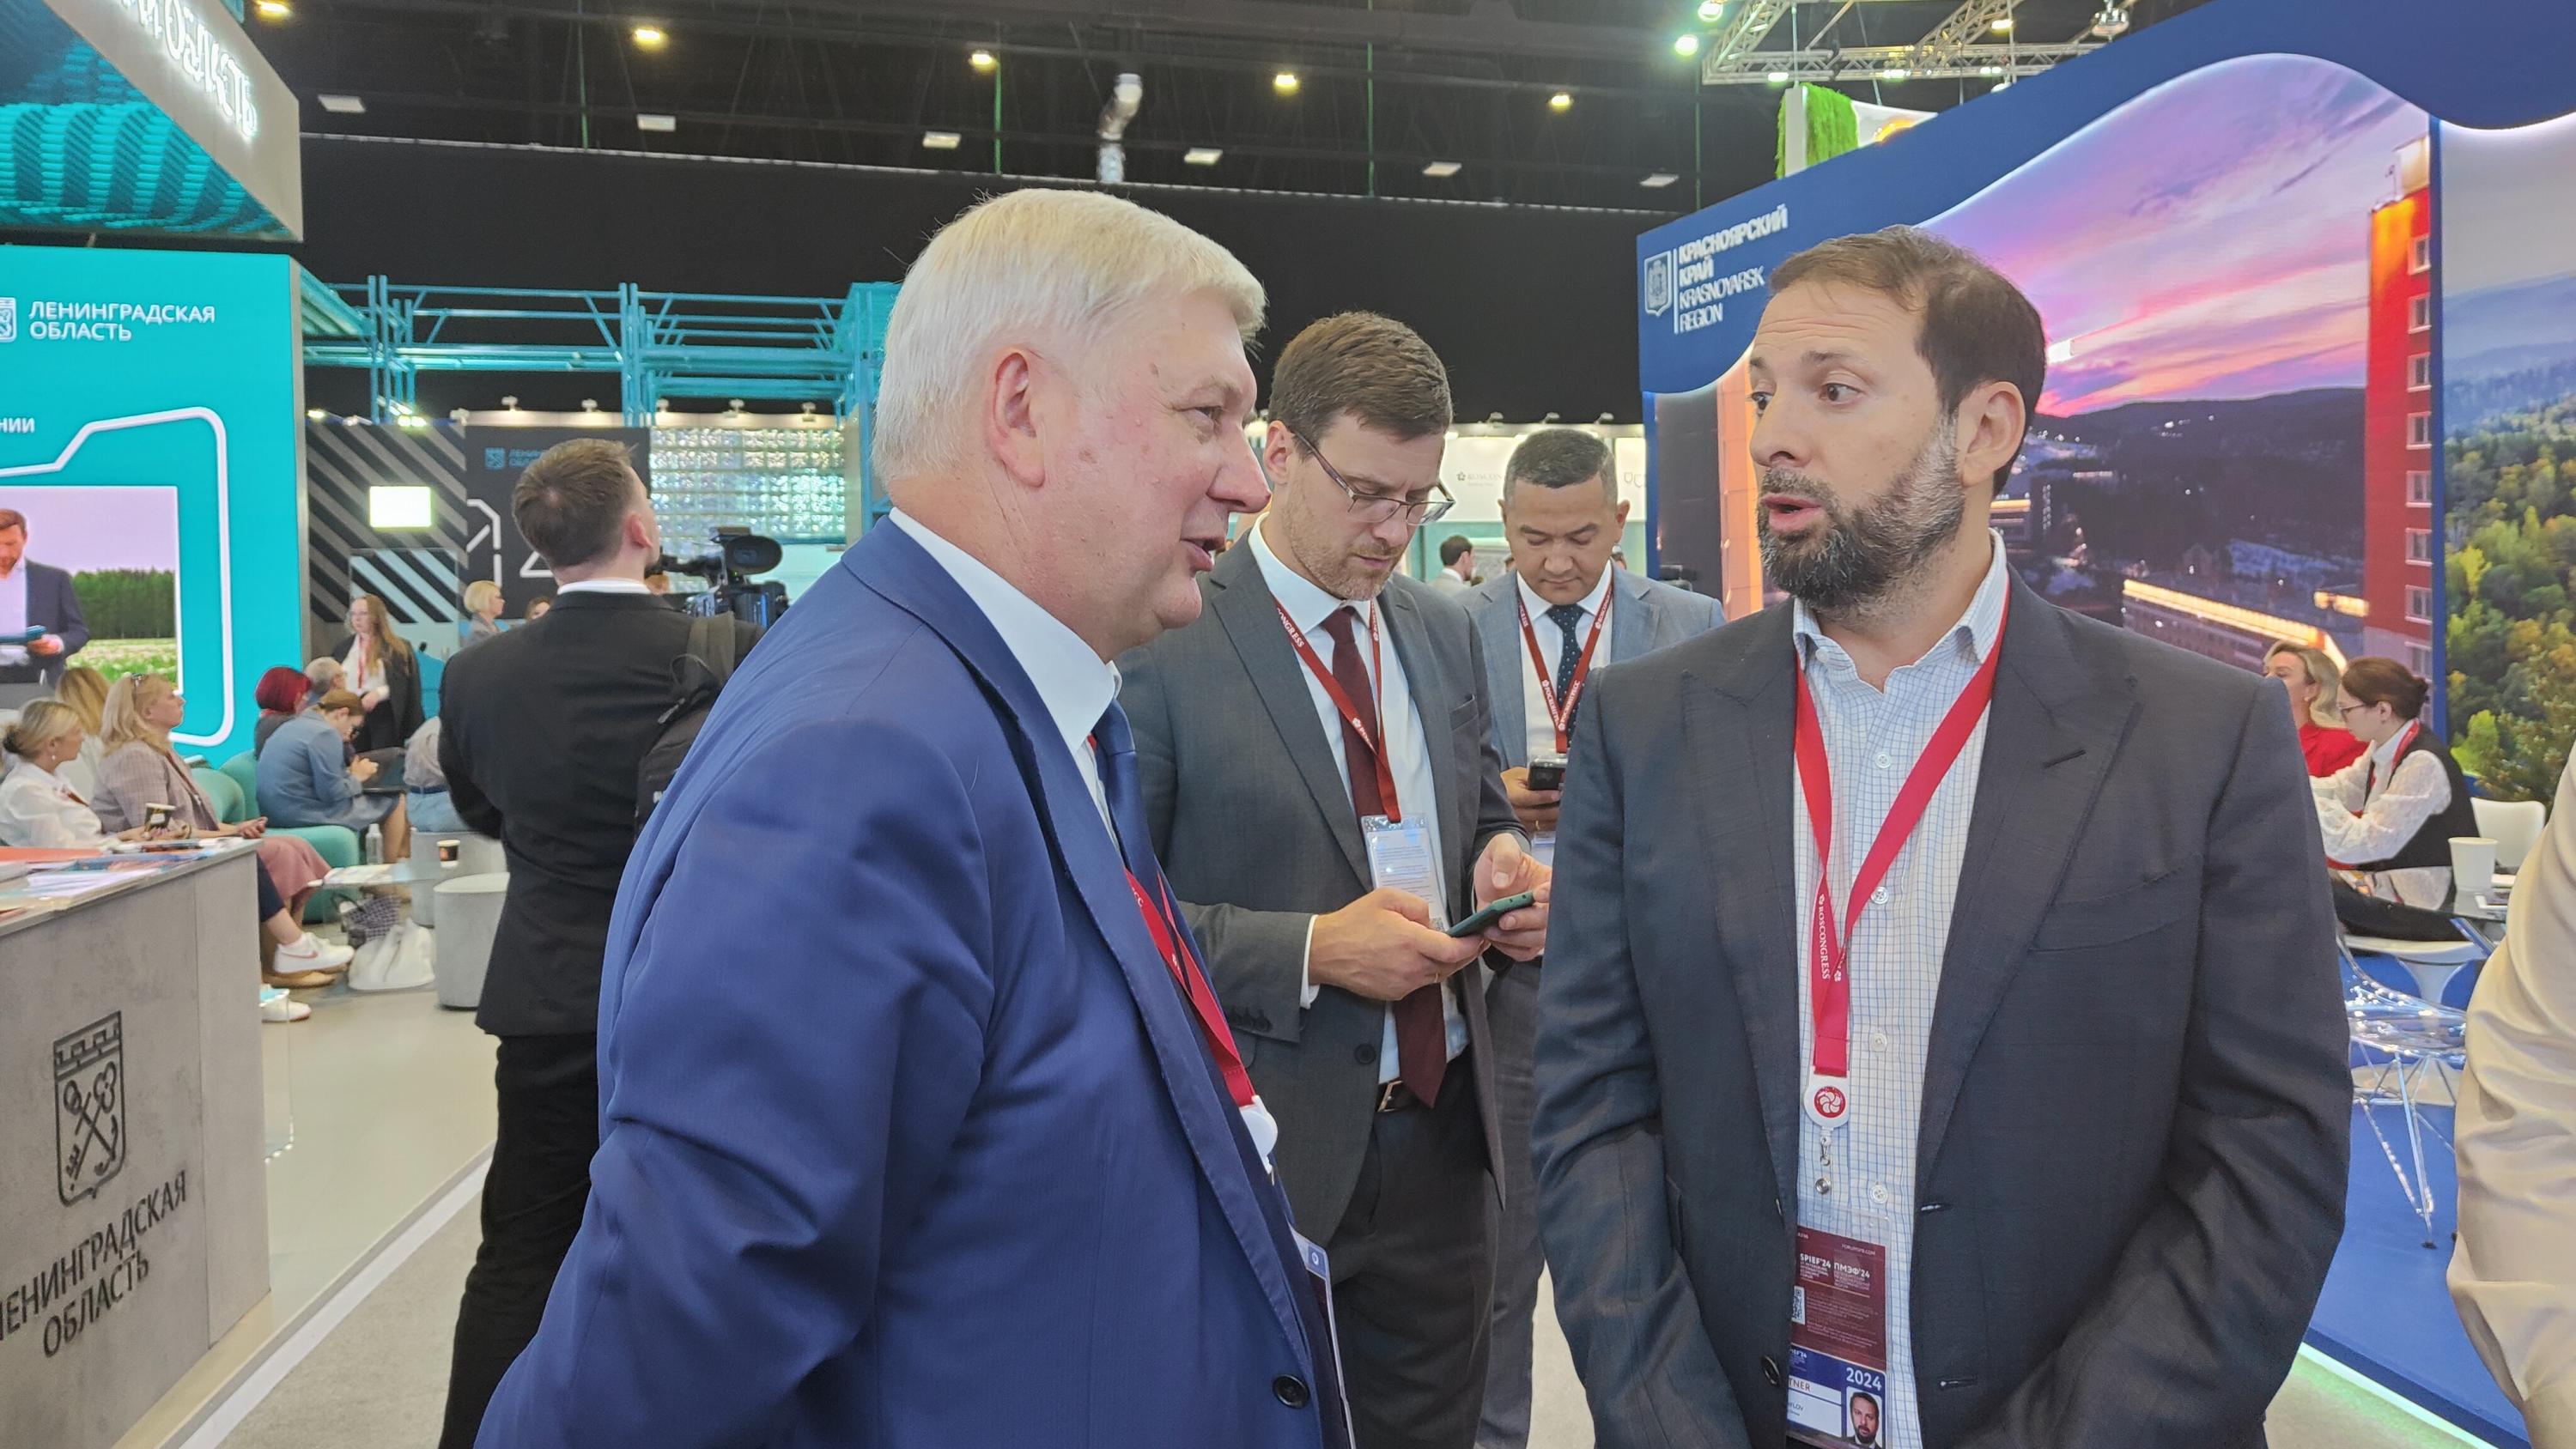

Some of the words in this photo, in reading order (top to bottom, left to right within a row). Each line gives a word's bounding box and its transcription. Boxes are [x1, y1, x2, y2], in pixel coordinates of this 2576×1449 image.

[1679, 203, 1788, 264] КРАСНОЯРСКИЙ
[1679, 256, 1714, 287] КРАЙ
[1680, 265, 1765, 310] KRASNOYARSK
[29, 300, 216, 325] ЛЕНИНГРАДСКАЯ
[1680, 303, 1723, 332] REGION
[29, 321, 132, 342] ОБЛАСТЬ
[1800, 1252, 1832, 1269] SPIEF'24
[1833, 1262, 1870, 1279] ПМЭФ'24
[44, 1250, 149, 1358] ОБЛАСТЬ
[1846, 1367, 1882, 1391] 2024
